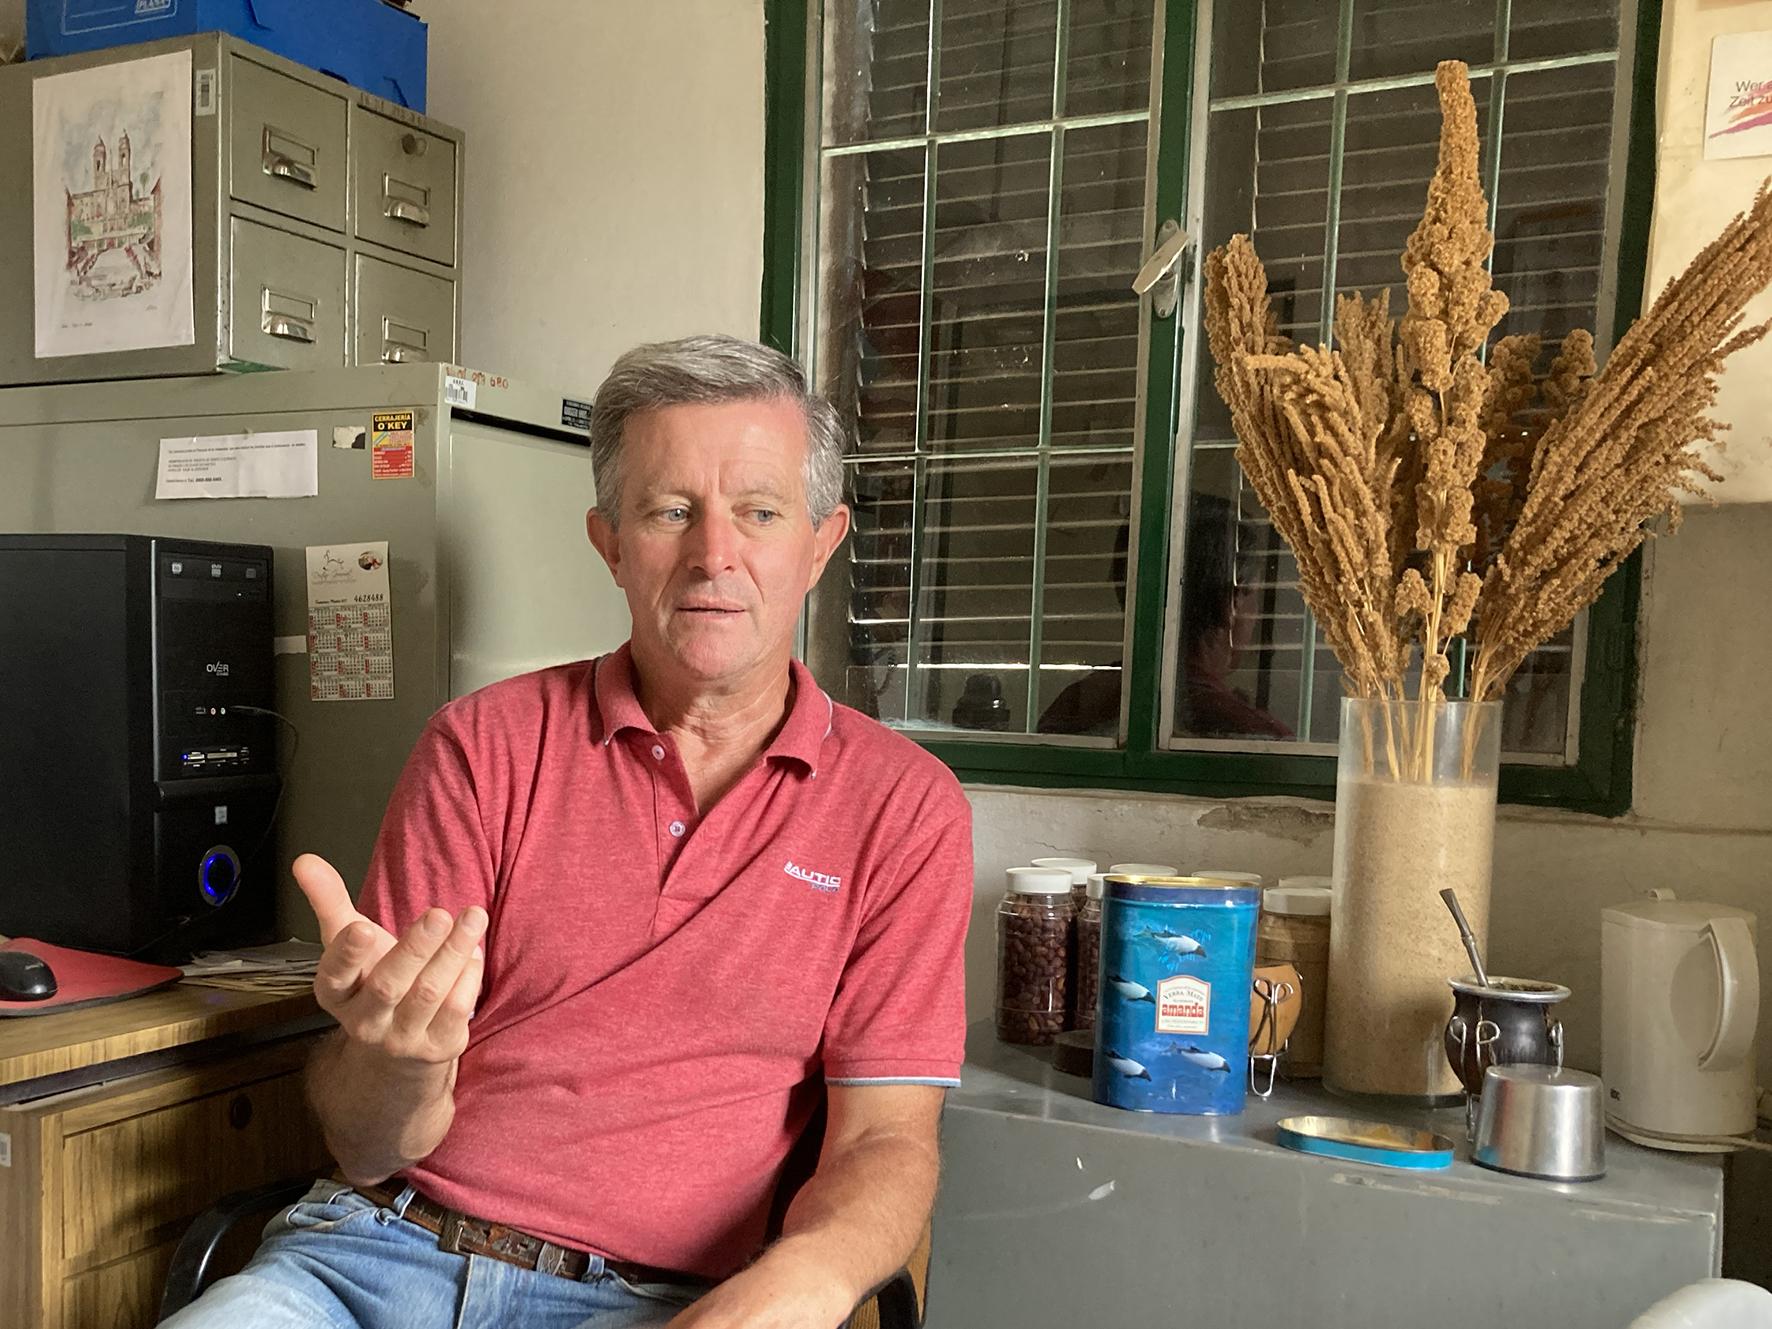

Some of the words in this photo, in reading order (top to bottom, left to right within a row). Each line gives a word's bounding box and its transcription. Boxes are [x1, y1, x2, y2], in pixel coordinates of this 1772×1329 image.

[1736, 80, 1764, 92] Wer
[1729, 94, 1755, 108] Zeit
[206, 661, 229, 673] OVER
[1161, 1002, 1205, 1018] amanda
